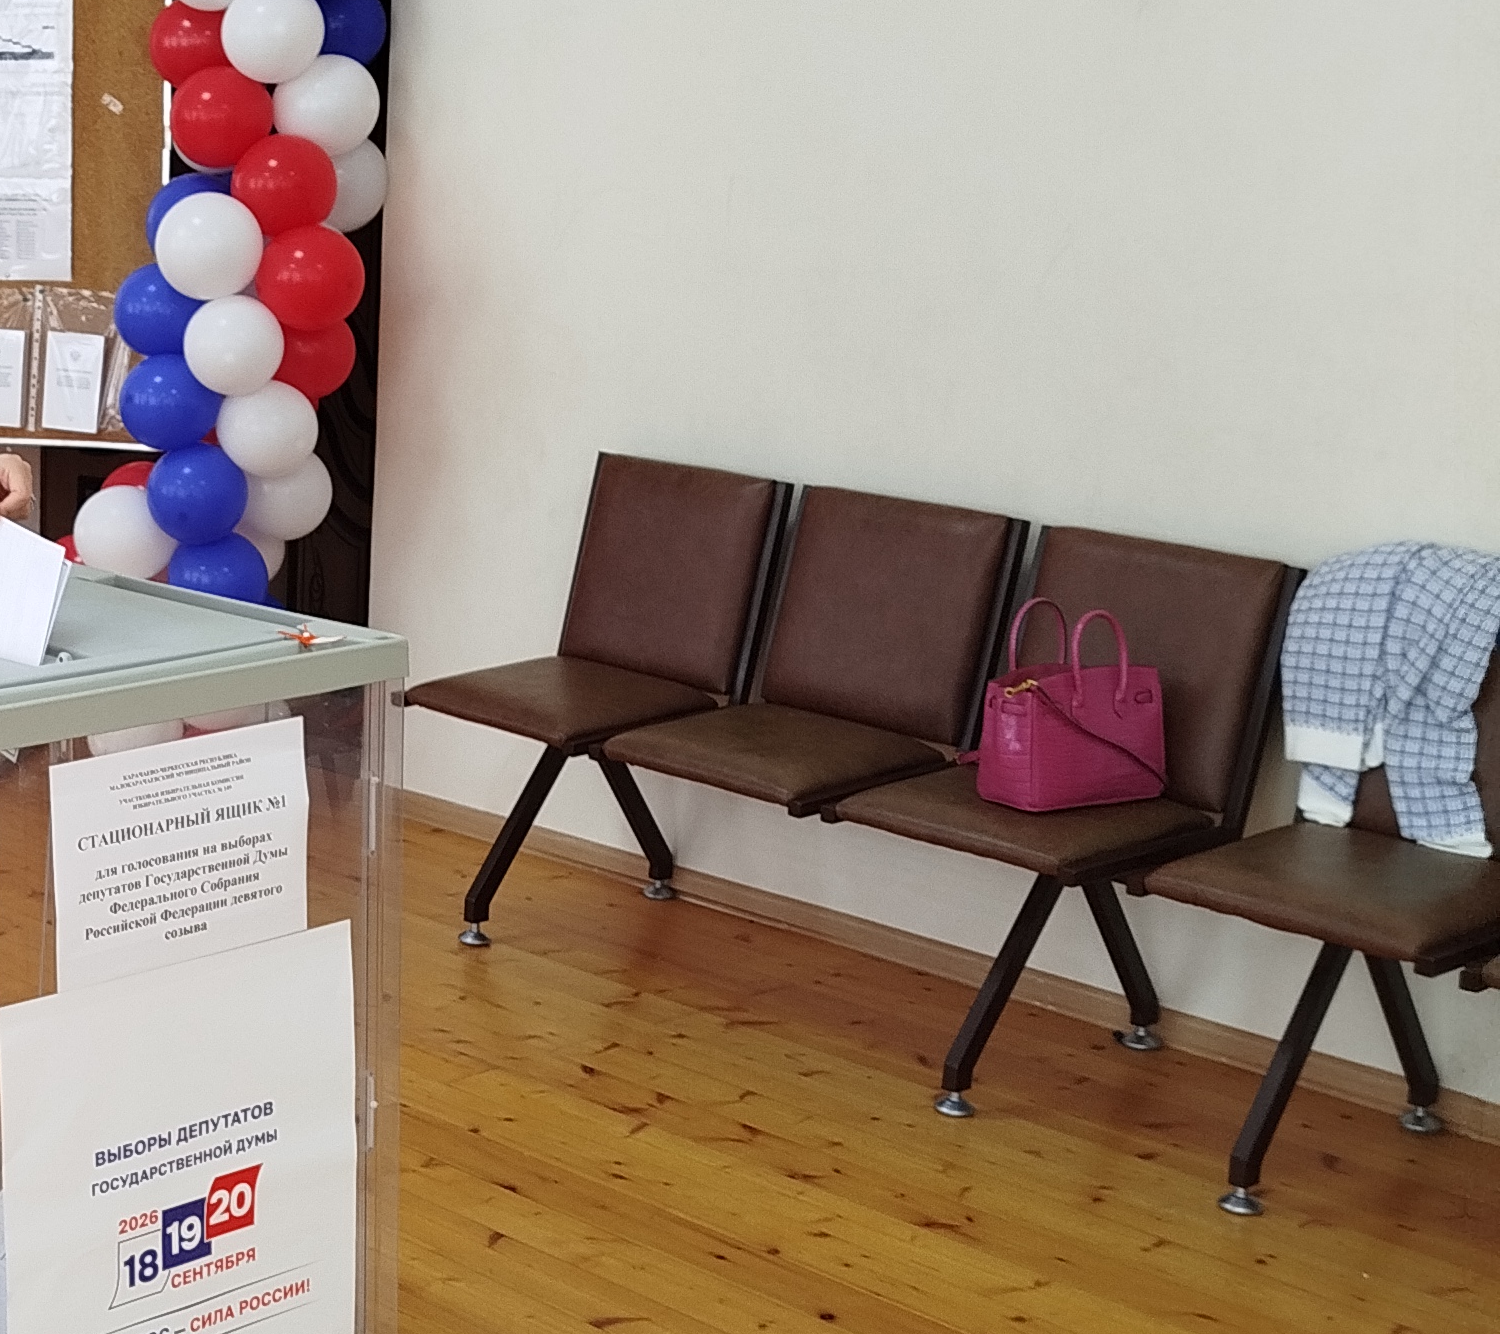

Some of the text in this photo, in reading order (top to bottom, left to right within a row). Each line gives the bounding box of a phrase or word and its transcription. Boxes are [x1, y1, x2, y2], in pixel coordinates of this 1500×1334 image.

[119, 774, 244, 805] УЧАСТКОВАЯ ИЗБИРАТЕЛЬНАЯ КОМИССИЯ
[123, 753, 237, 781] КАРАЧАЕВО-ЧЕРКЕССКАЯ РЕСПУБЛИКА
[176, 761, 231, 779] МУНИЦИПАЛЬНЫЙ
[232, 757, 252, 768] РАЙОН
[132, 794, 187, 810] ИЗБИРАТЕЛЬНОГО
[188, 788, 216, 799] УЧАСТКА
[77, 795, 286, 852] СТАЦИОНАРНЫЙ ЯЩИК №1
[78, 847, 288, 905] депутатов Государственной Думы
[95, 831, 273, 881] для голосования на выборах
[85, 885, 283, 941] Российской Федерации девятого
[109, 871, 260, 916] Федерального Собрания
[164, 921, 208, 940] созыва
[95, 1101, 273, 1167] ВЫБОРЫ ДЕПУТАТОВ
[91, 1128, 278, 1197] ГОСУДАРСТВЕННОЙ ДУМЫ
[118, 1210, 159, 1235] 2026
[123, 1182, 252, 1288] 18 19 20
[170, 1247, 257, 1289] СЕНТЯБРЯ
[190, 1305, 235, 1333] СИЛА
[239, 1278, 311, 1316] РОССИИ!
